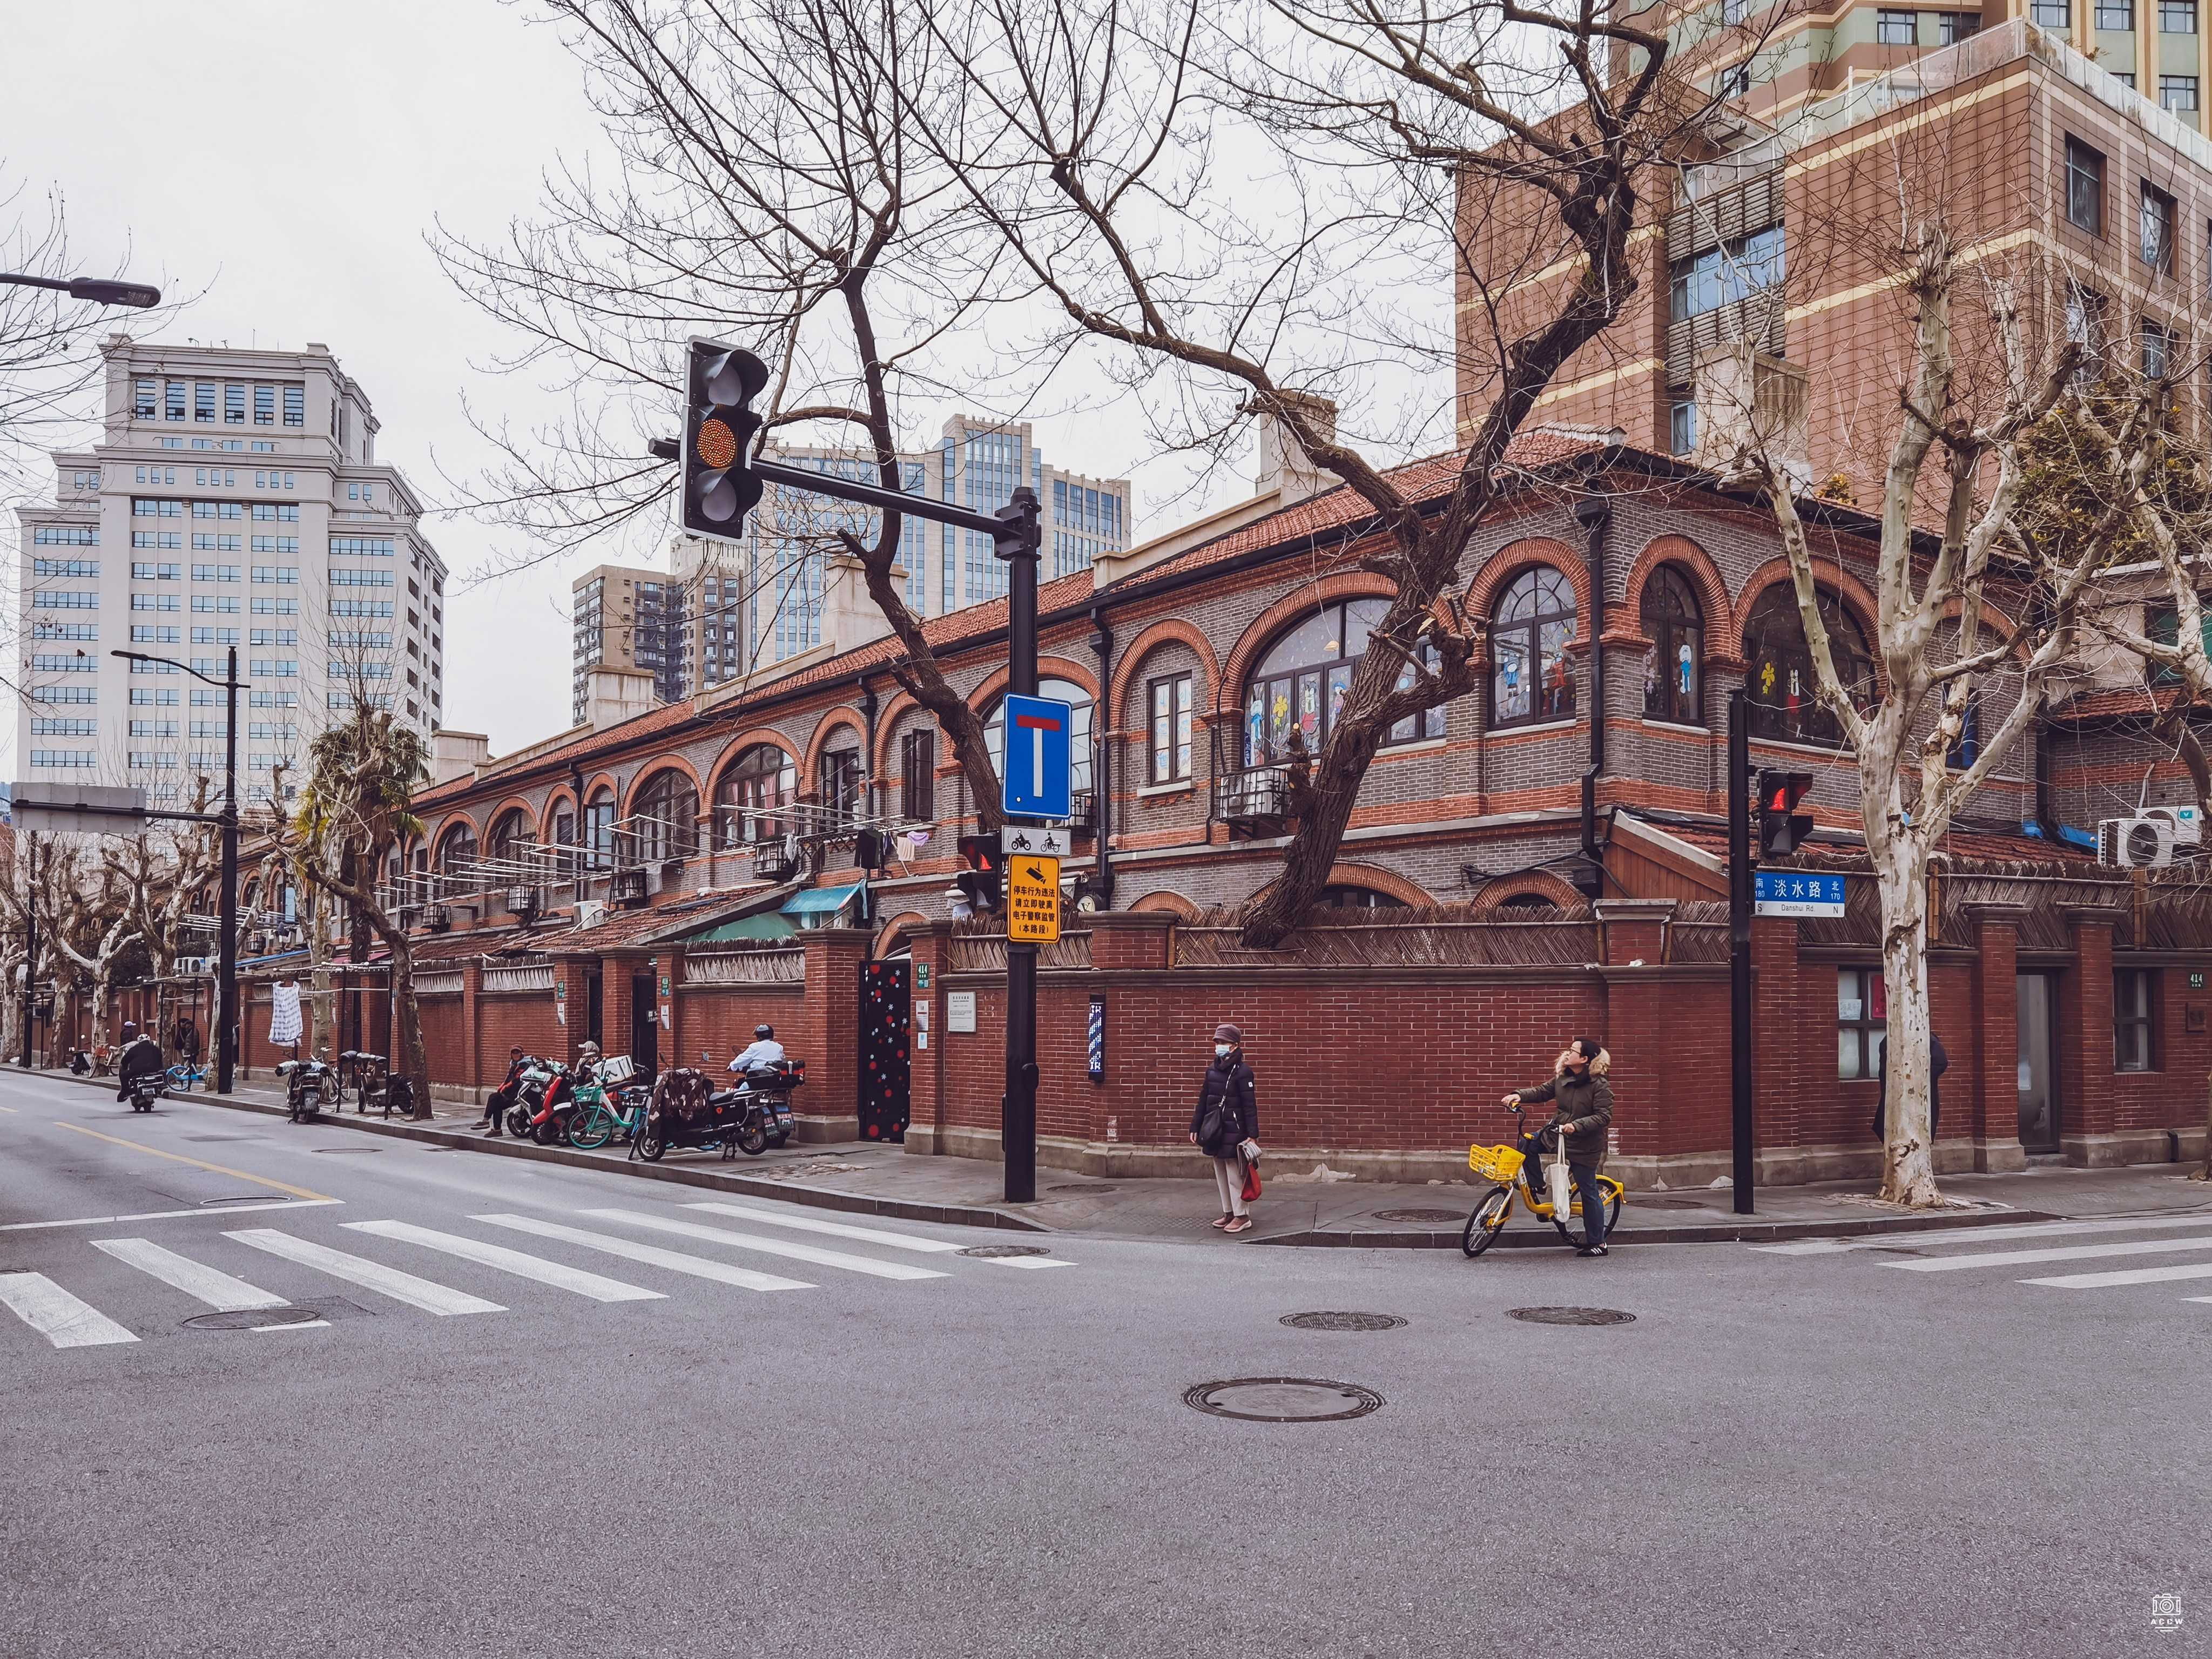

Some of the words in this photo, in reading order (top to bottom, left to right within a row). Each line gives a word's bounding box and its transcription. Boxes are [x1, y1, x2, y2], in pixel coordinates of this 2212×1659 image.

[1756, 878, 1763, 889] 南
[1775, 879, 1821, 899] 淡水路
[1831, 881, 1839, 891] 北
[1013, 886, 1055, 897] 停车行为违法
[1015, 898, 1053, 909] 请立即驶离
[1757, 903, 1763, 912] S
[1013, 911, 1055, 922] 电子警察监管
[2190, 974, 2202, 982] 414
